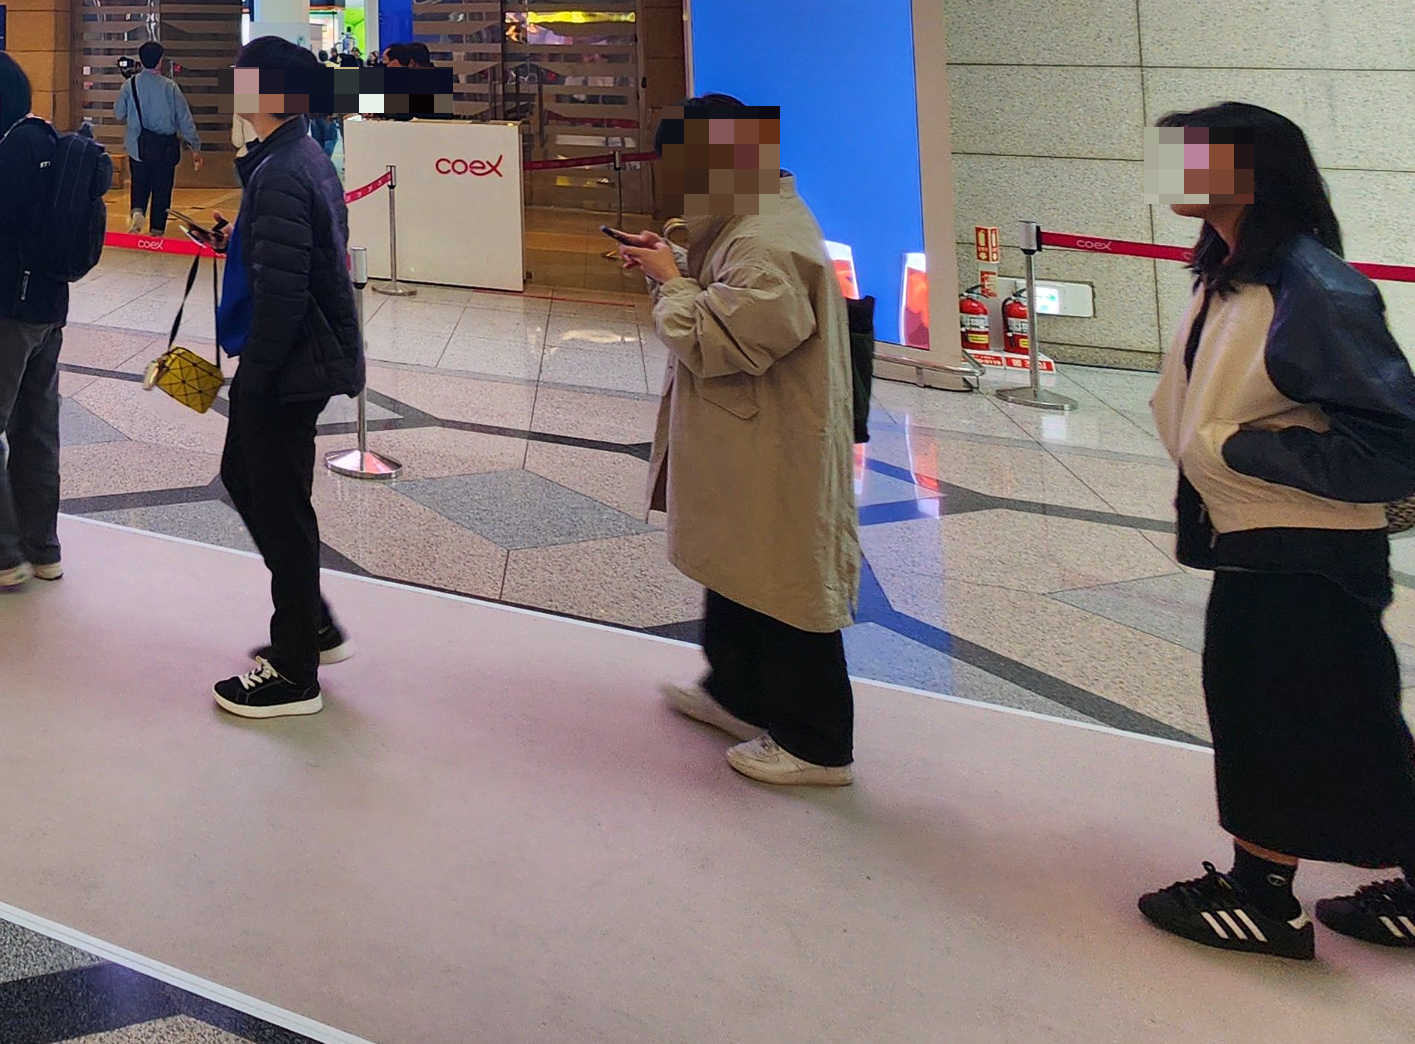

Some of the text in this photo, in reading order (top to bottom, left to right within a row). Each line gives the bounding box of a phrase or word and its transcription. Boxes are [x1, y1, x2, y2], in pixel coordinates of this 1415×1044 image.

[435, 154, 503, 178] coex
[137, 239, 163, 250] coex
[1076, 239, 1112, 251] coex
